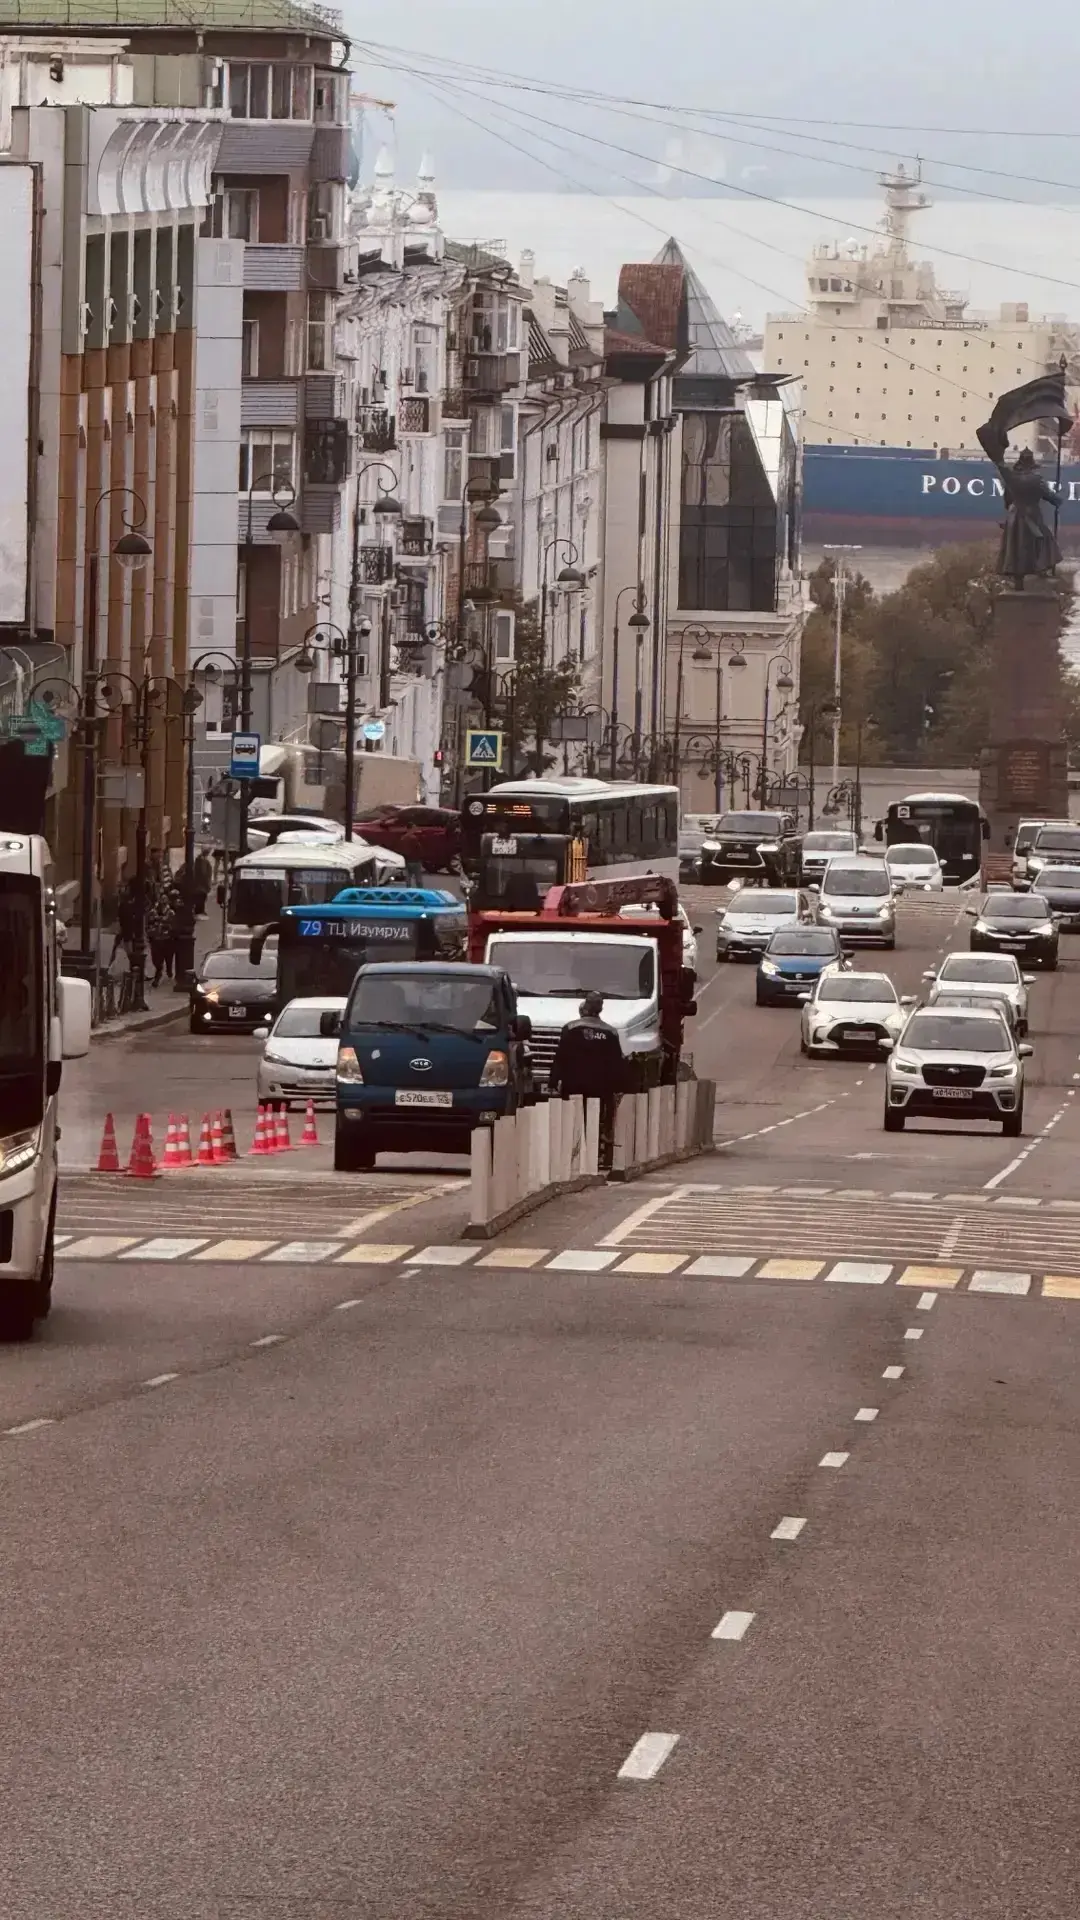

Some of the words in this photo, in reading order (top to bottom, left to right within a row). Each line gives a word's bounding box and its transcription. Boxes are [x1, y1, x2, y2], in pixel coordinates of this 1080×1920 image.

[300, 920, 322, 936] 79
[327, 922, 347, 937] ТЦ
[350, 922, 410, 939] Изумруд
